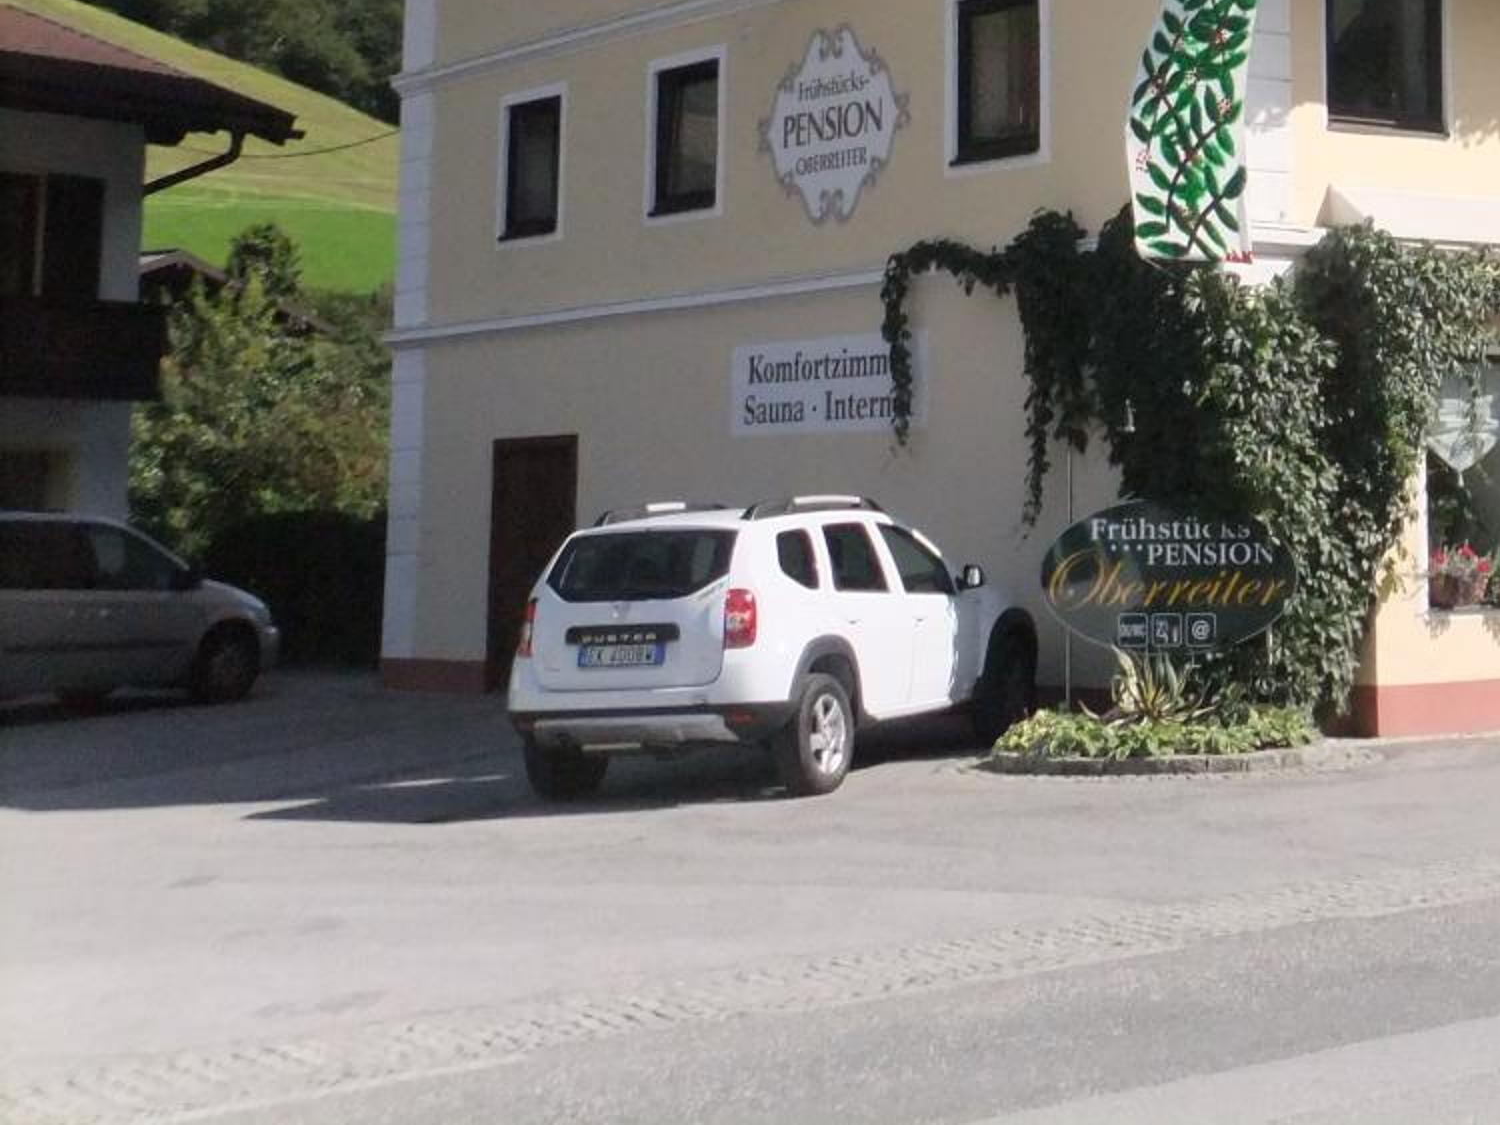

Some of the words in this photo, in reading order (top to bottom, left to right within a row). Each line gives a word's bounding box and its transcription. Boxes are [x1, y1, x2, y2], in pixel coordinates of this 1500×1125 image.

[783, 96, 883, 150] PENSION
[747, 348, 889, 385] Komfortzimm
[743, 394, 805, 426] Sauna
[1147, 542, 1274, 566] PENSION
